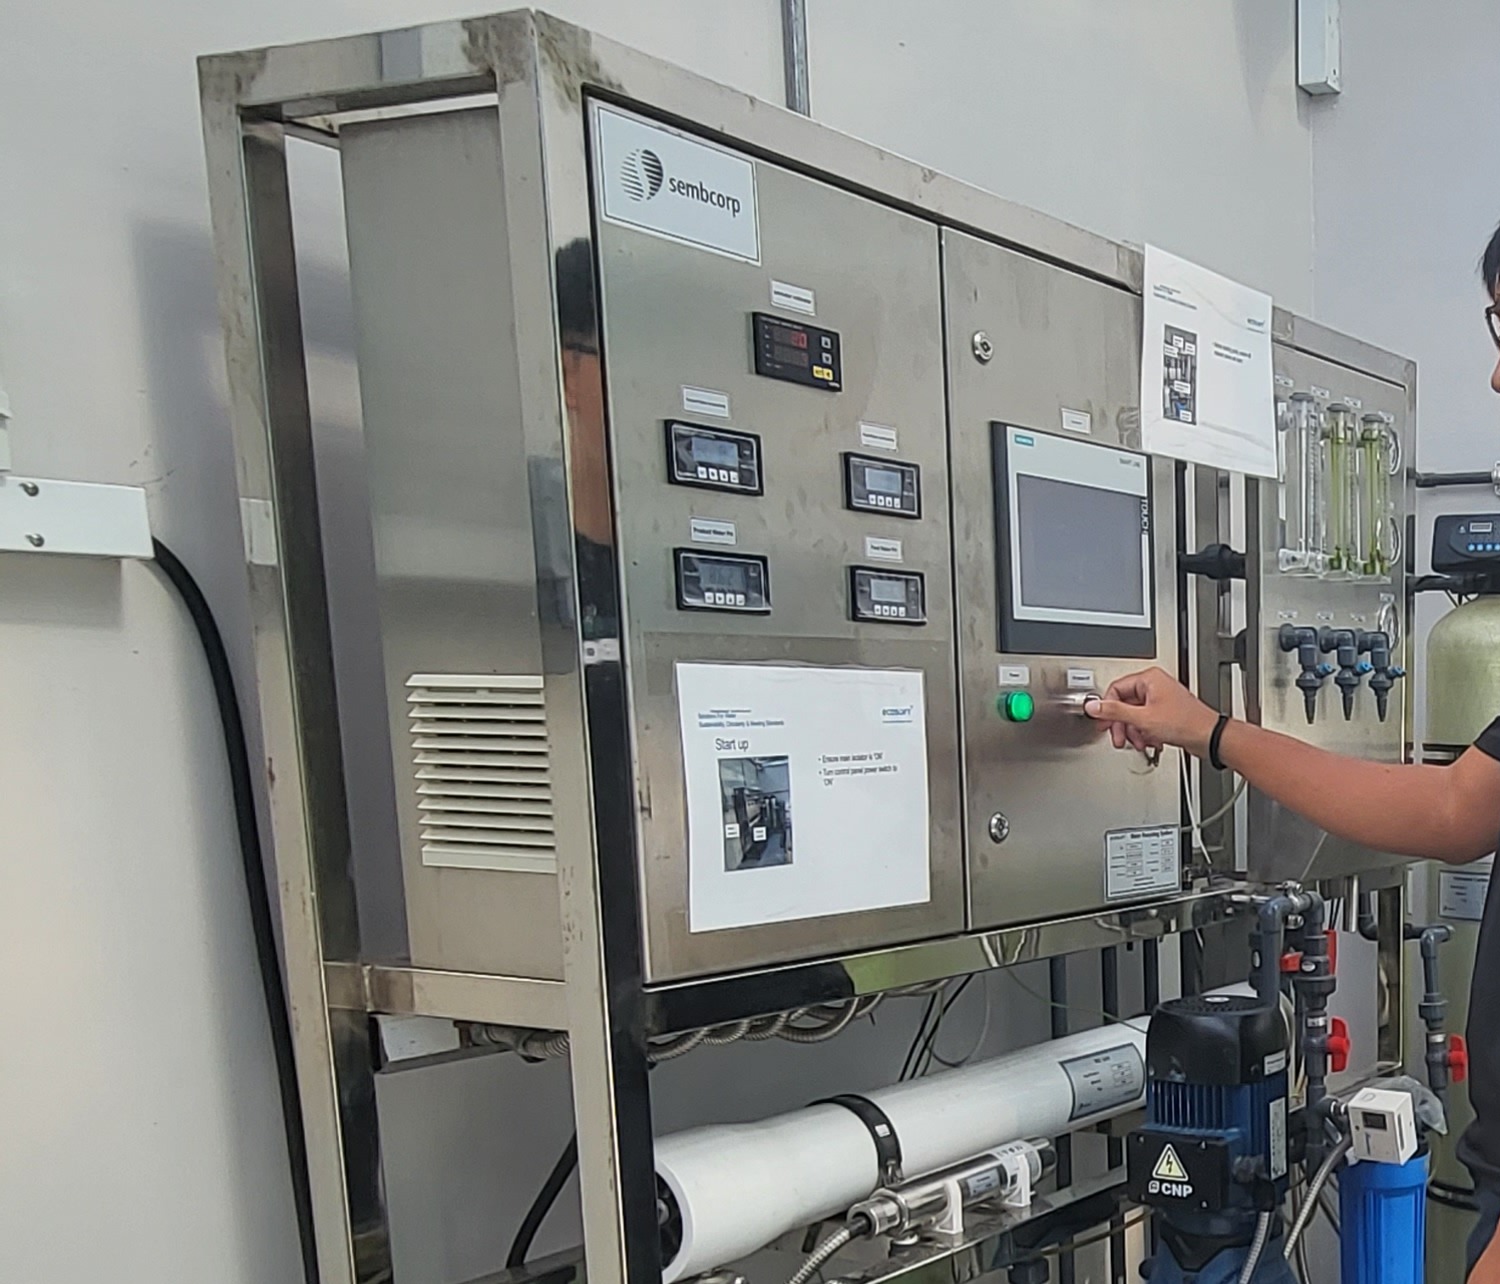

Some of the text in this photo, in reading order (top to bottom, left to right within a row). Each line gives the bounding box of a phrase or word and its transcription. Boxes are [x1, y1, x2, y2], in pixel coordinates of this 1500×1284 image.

[669, 176, 741, 218] sembcorp
[715, 738, 749, 753] Start up
[1161, 1182, 1193, 1198] CNP
